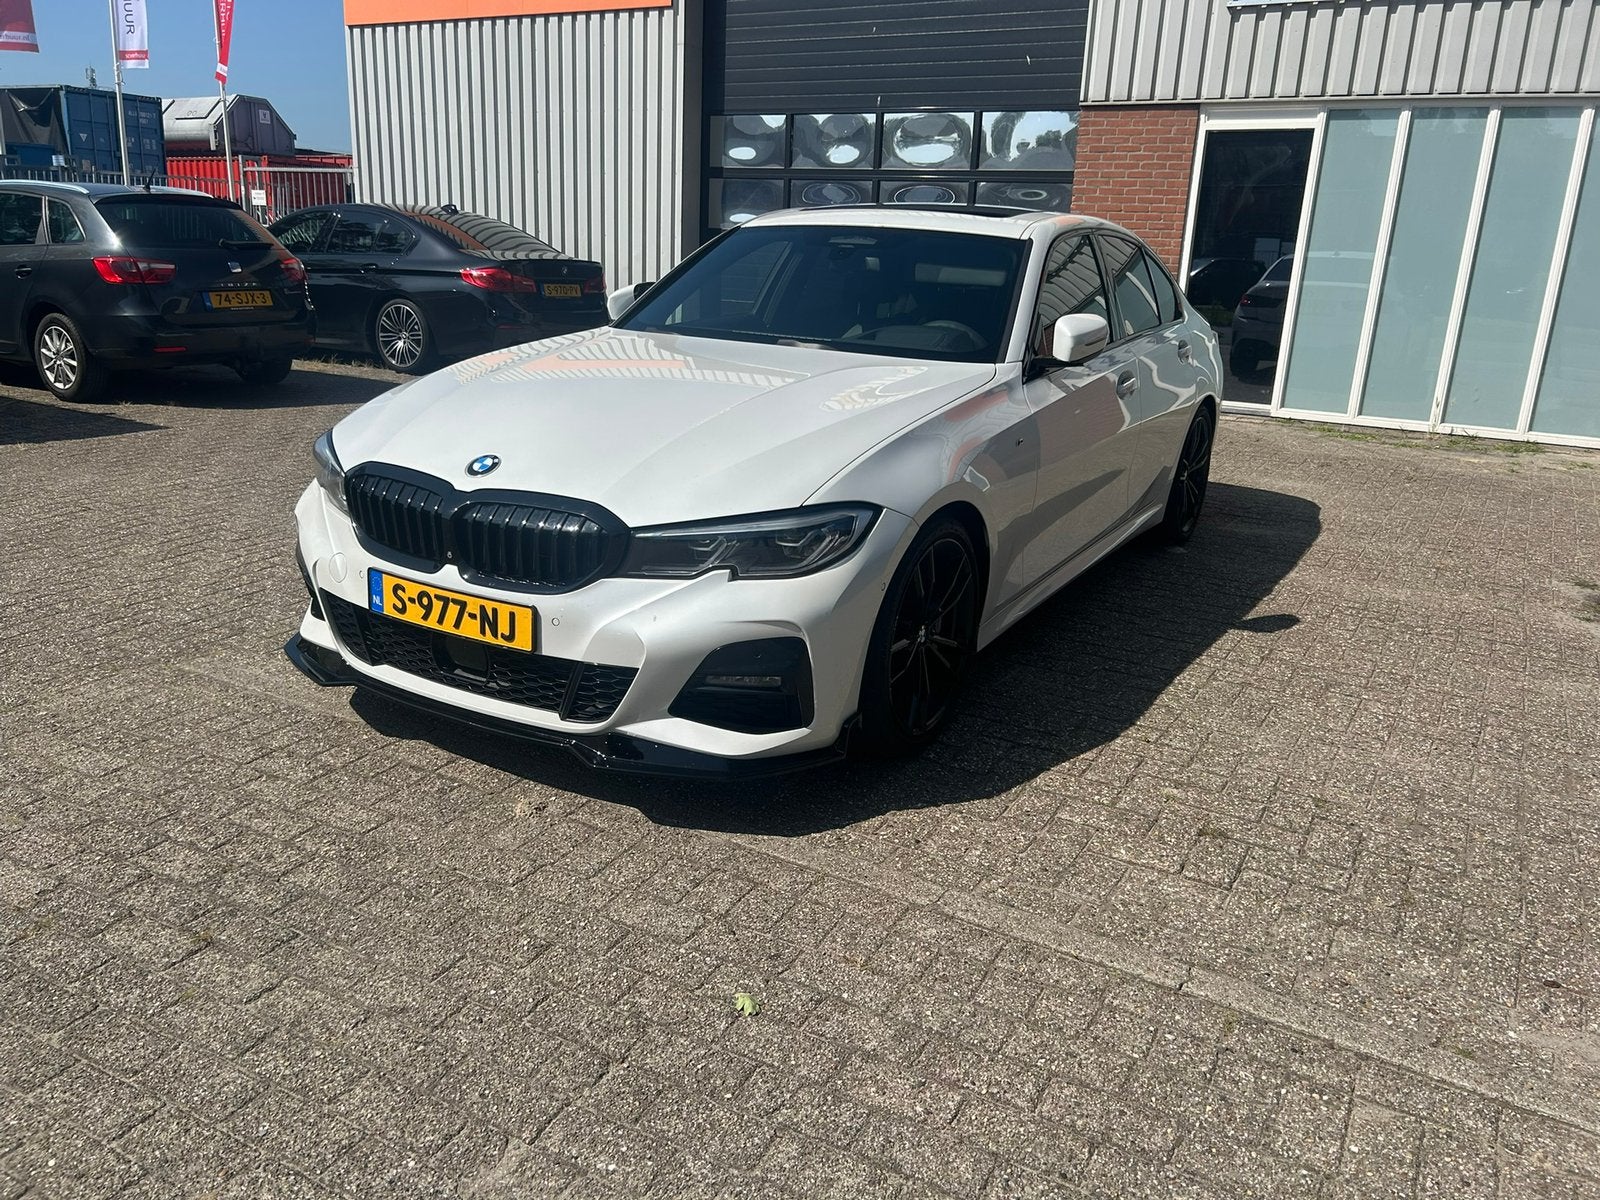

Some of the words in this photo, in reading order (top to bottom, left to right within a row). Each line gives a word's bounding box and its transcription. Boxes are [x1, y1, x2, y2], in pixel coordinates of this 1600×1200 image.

[123, 0, 136, 35] UUR
[215, 292, 267, 306] 74-SJX-3
[372, 595, 383, 607] NL
[391, 583, 516, 644] S-977-NJ
